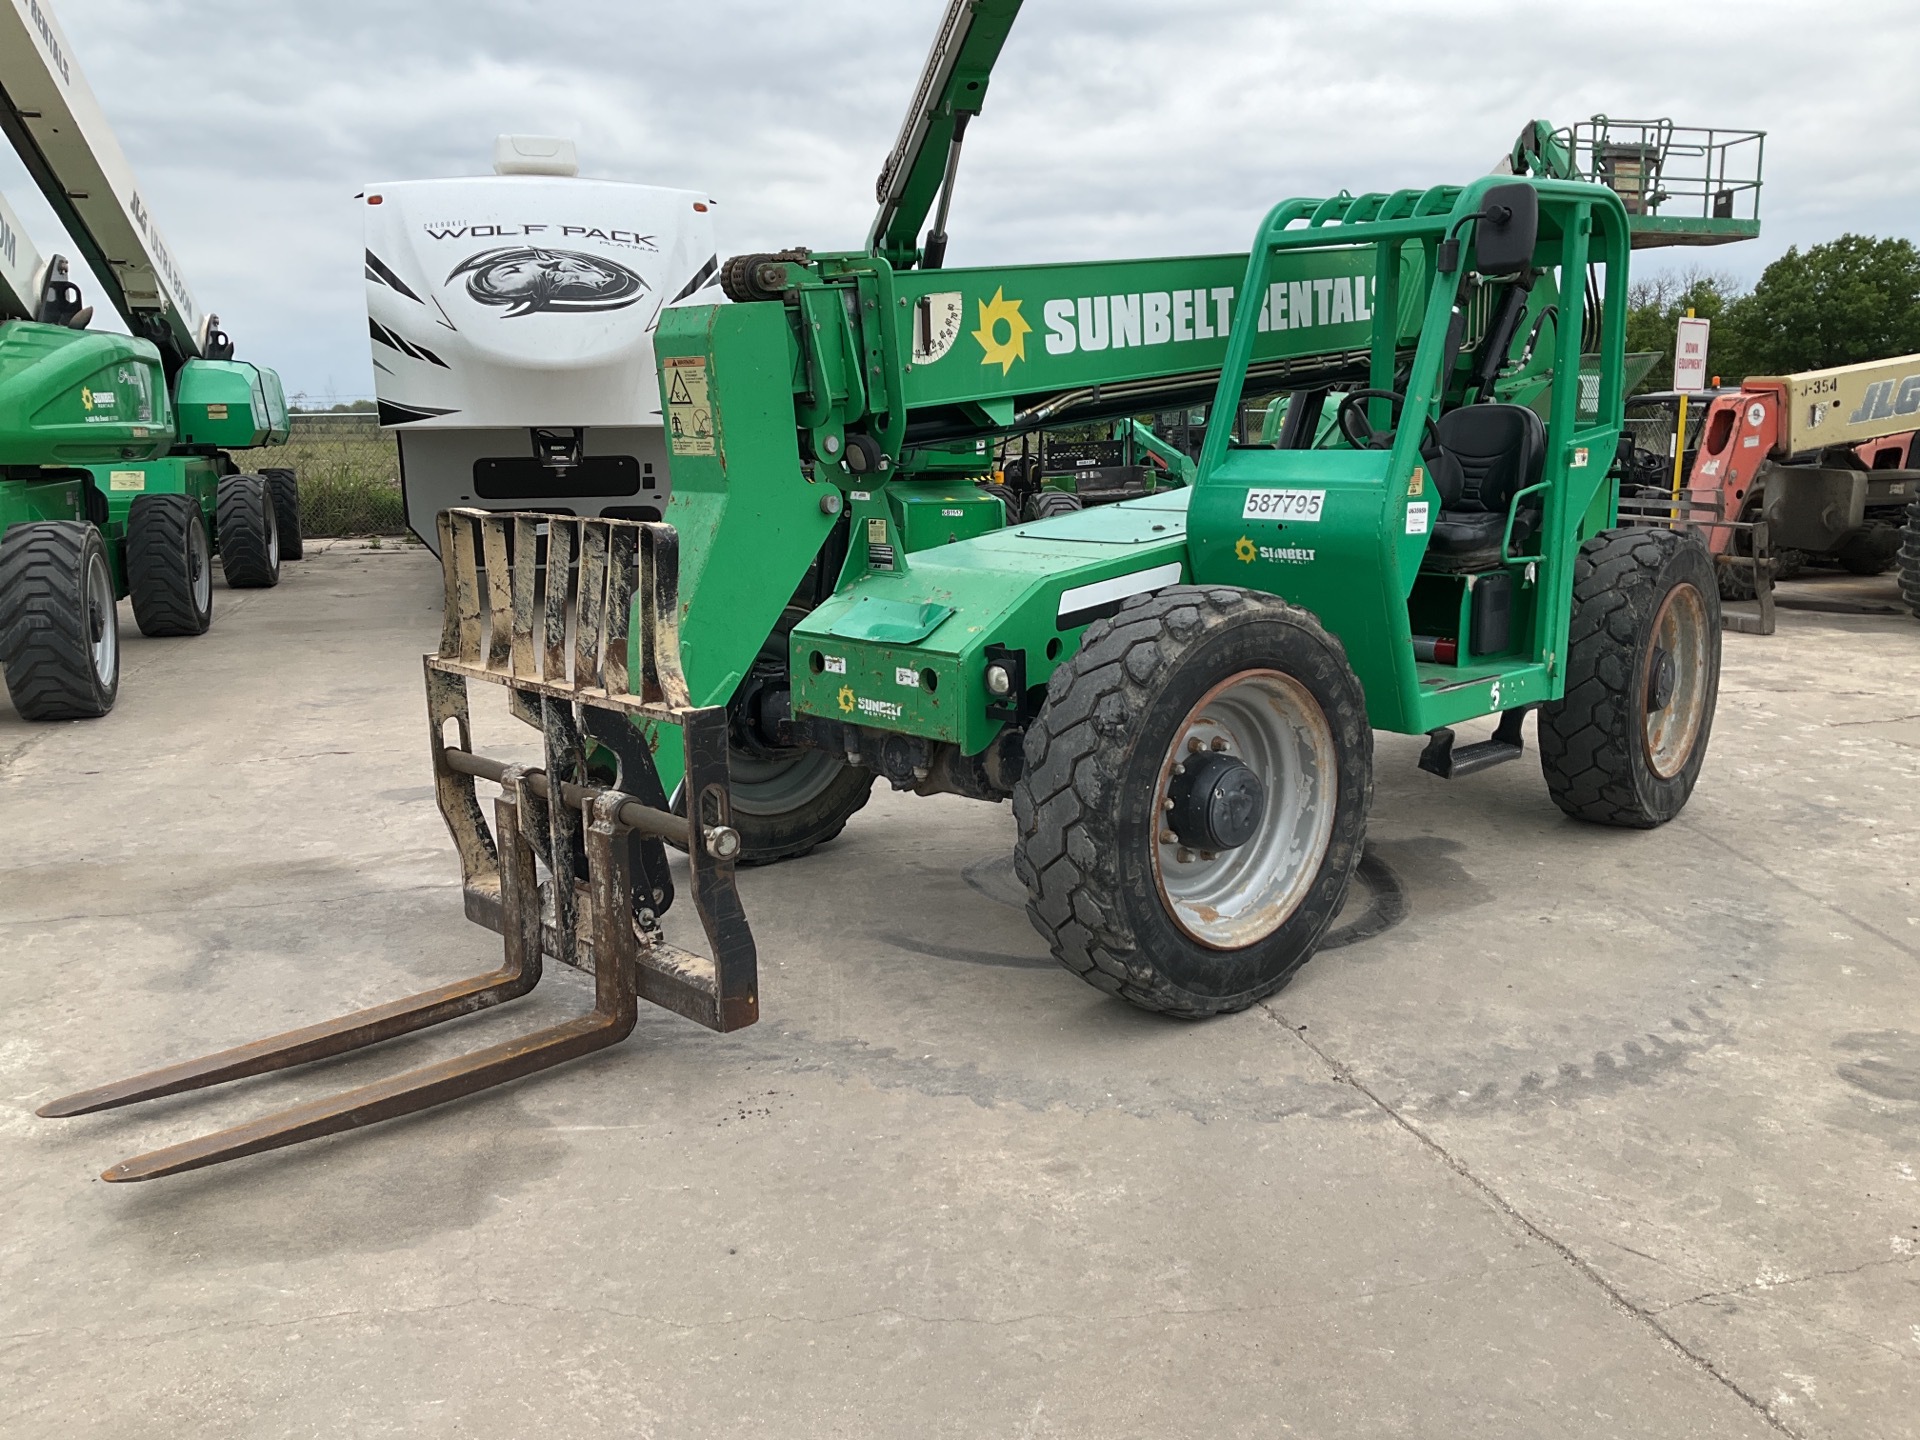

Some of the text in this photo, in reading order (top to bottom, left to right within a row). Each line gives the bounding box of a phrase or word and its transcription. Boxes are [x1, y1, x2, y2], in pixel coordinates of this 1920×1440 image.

[31, 0, 69, 86] RENTALS
[424, 220, 468, 229] CHEROKEE
[426, 225, 659, 247] WOLF PACK
[130, 189, 192, 323] JLG ULTRA BOOM
[599, 240, 660, 253] PLATINUM
[1043, 275, 1376, 355] SUNBELT ENTAL
[1685, 342, 1699, 353] DOWN
[1679, 358, 1703, 370] EQUIPMENT
[1801, 378, 1838, 397] J-354
[1846, 374, 1920, 426] JLG
[1247, 494, 1321, 514] 587795
[857, 696, 903, 717] SUNBELT
